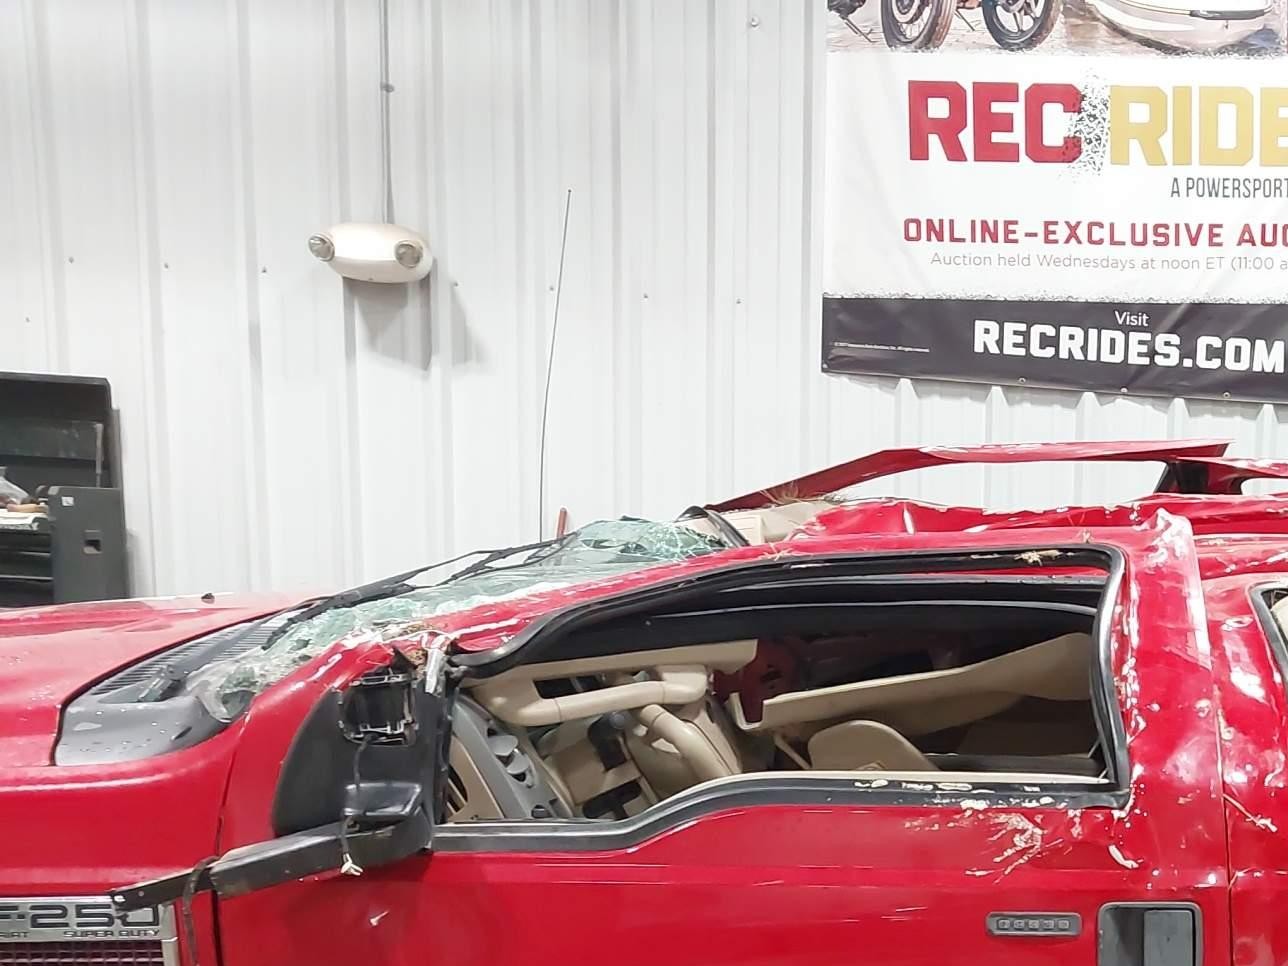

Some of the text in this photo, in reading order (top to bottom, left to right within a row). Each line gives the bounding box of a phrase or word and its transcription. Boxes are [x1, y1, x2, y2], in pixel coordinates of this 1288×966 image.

[908, 80, 1083, 163] REC
[1171, 178, 1181, 198] A
[904, 217, 1224, 247] ONLINE-EXCLUSIVE
[931, 252, 993, 267] Auction
[997, 252, 1035, 267] held
[1037, 253, 1135, 271] Wednesdays
[1141, 256, 1156, 269] at
[1161, 259, 1200, 270] noon
[1206, 257, 1225, 270] ET
[1231, 256, 1275, 272] (11:00
[1114, 310, 1149, 328] Visit
[974, 320, 1286, 374] RECRIDES.COM
[64, 930, 114, 938] SUPER
[119, 929, 160, 937] DUTY
